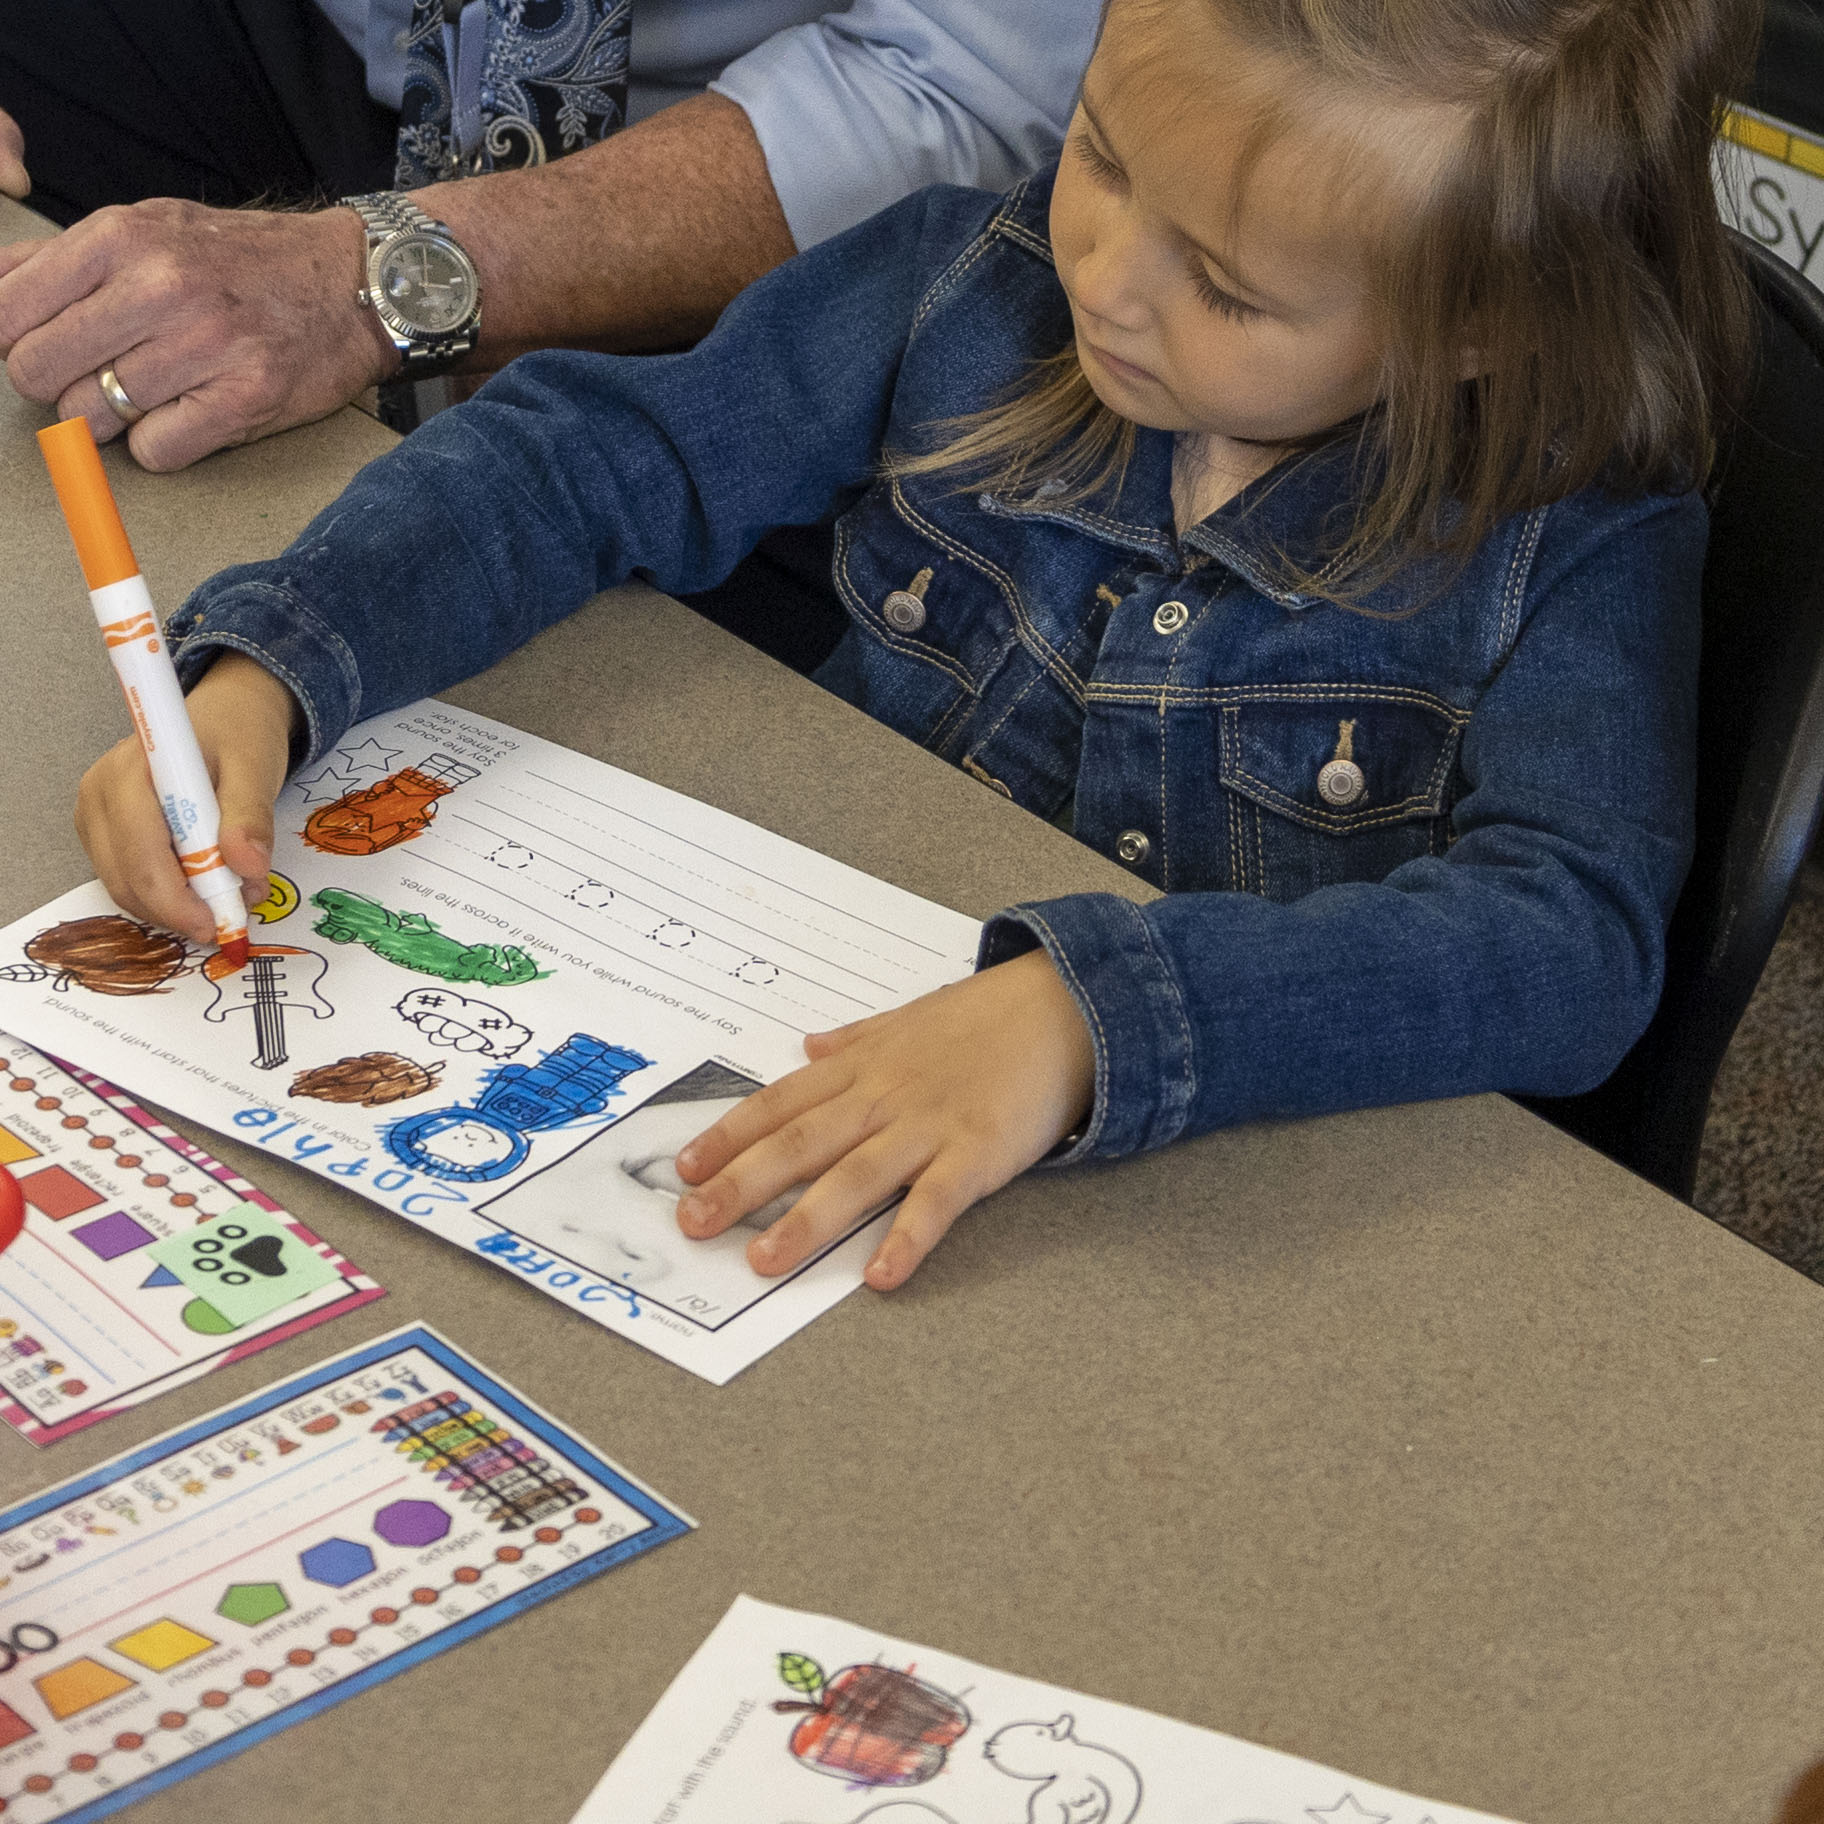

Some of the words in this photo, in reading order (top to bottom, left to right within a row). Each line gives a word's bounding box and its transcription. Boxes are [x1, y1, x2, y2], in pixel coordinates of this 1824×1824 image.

[128, 684, 158, 752] Crayola.com
[413, 713, 452, 738] once
[427, 708, 457, 728] star.
[392, 717, 442, 748] sound
[454, 730, 495, 756] times,
[458, 720, 498, 745] each
[496, 736, 520, 754] for
[440, 738, 467, 758] the
[466, 748, 497, 770] Say
[491, 747, 506, 761] 3
[394, 873, 434, 900] lines.
[429, 889, 459, 910] the
[458, 901, 509, 932] across
[505, 923, 521, 938] it
[519, 930, 560, 957] write
[557, 945, 592, 971] you
[590, 963, 633, 991] while
[39, 993, 93, 1023] sound.
[630, 980, 682, 1012] sound
[680, 1002, 709, 1024] the
[708, 1012, 744, 1039] Say
[87, 1016, 119, 1036] the
[7, 1039, 34, 1065] 12
[113, 1028, 154, 1053] with
[148, 1046, 189, 1070] start
[33, 1061, 60, 1086] 11
[184, 1062, 222, 1085] that
[59, 1081, 86, 1106] 10
[219, 1079, 286, 1115] pictures
[87, 1100, 108, 1121] 9
[281, 1108, 312, 1127] the
[2, 1108, 62, 1157] trapezoid
[116, 1122, 136, 1142] 8
[308, 1120, 329, 1134] in
[141, 1140, 160, 1159] 7
[323, 1126, 374, 1155] Color
[66, 1155, 124, 1202] rectangle
[170, 1160, 190, 1180] 6
[196, 1177, 217, 1197] 5
[126, 1199, 175, 1240] square
